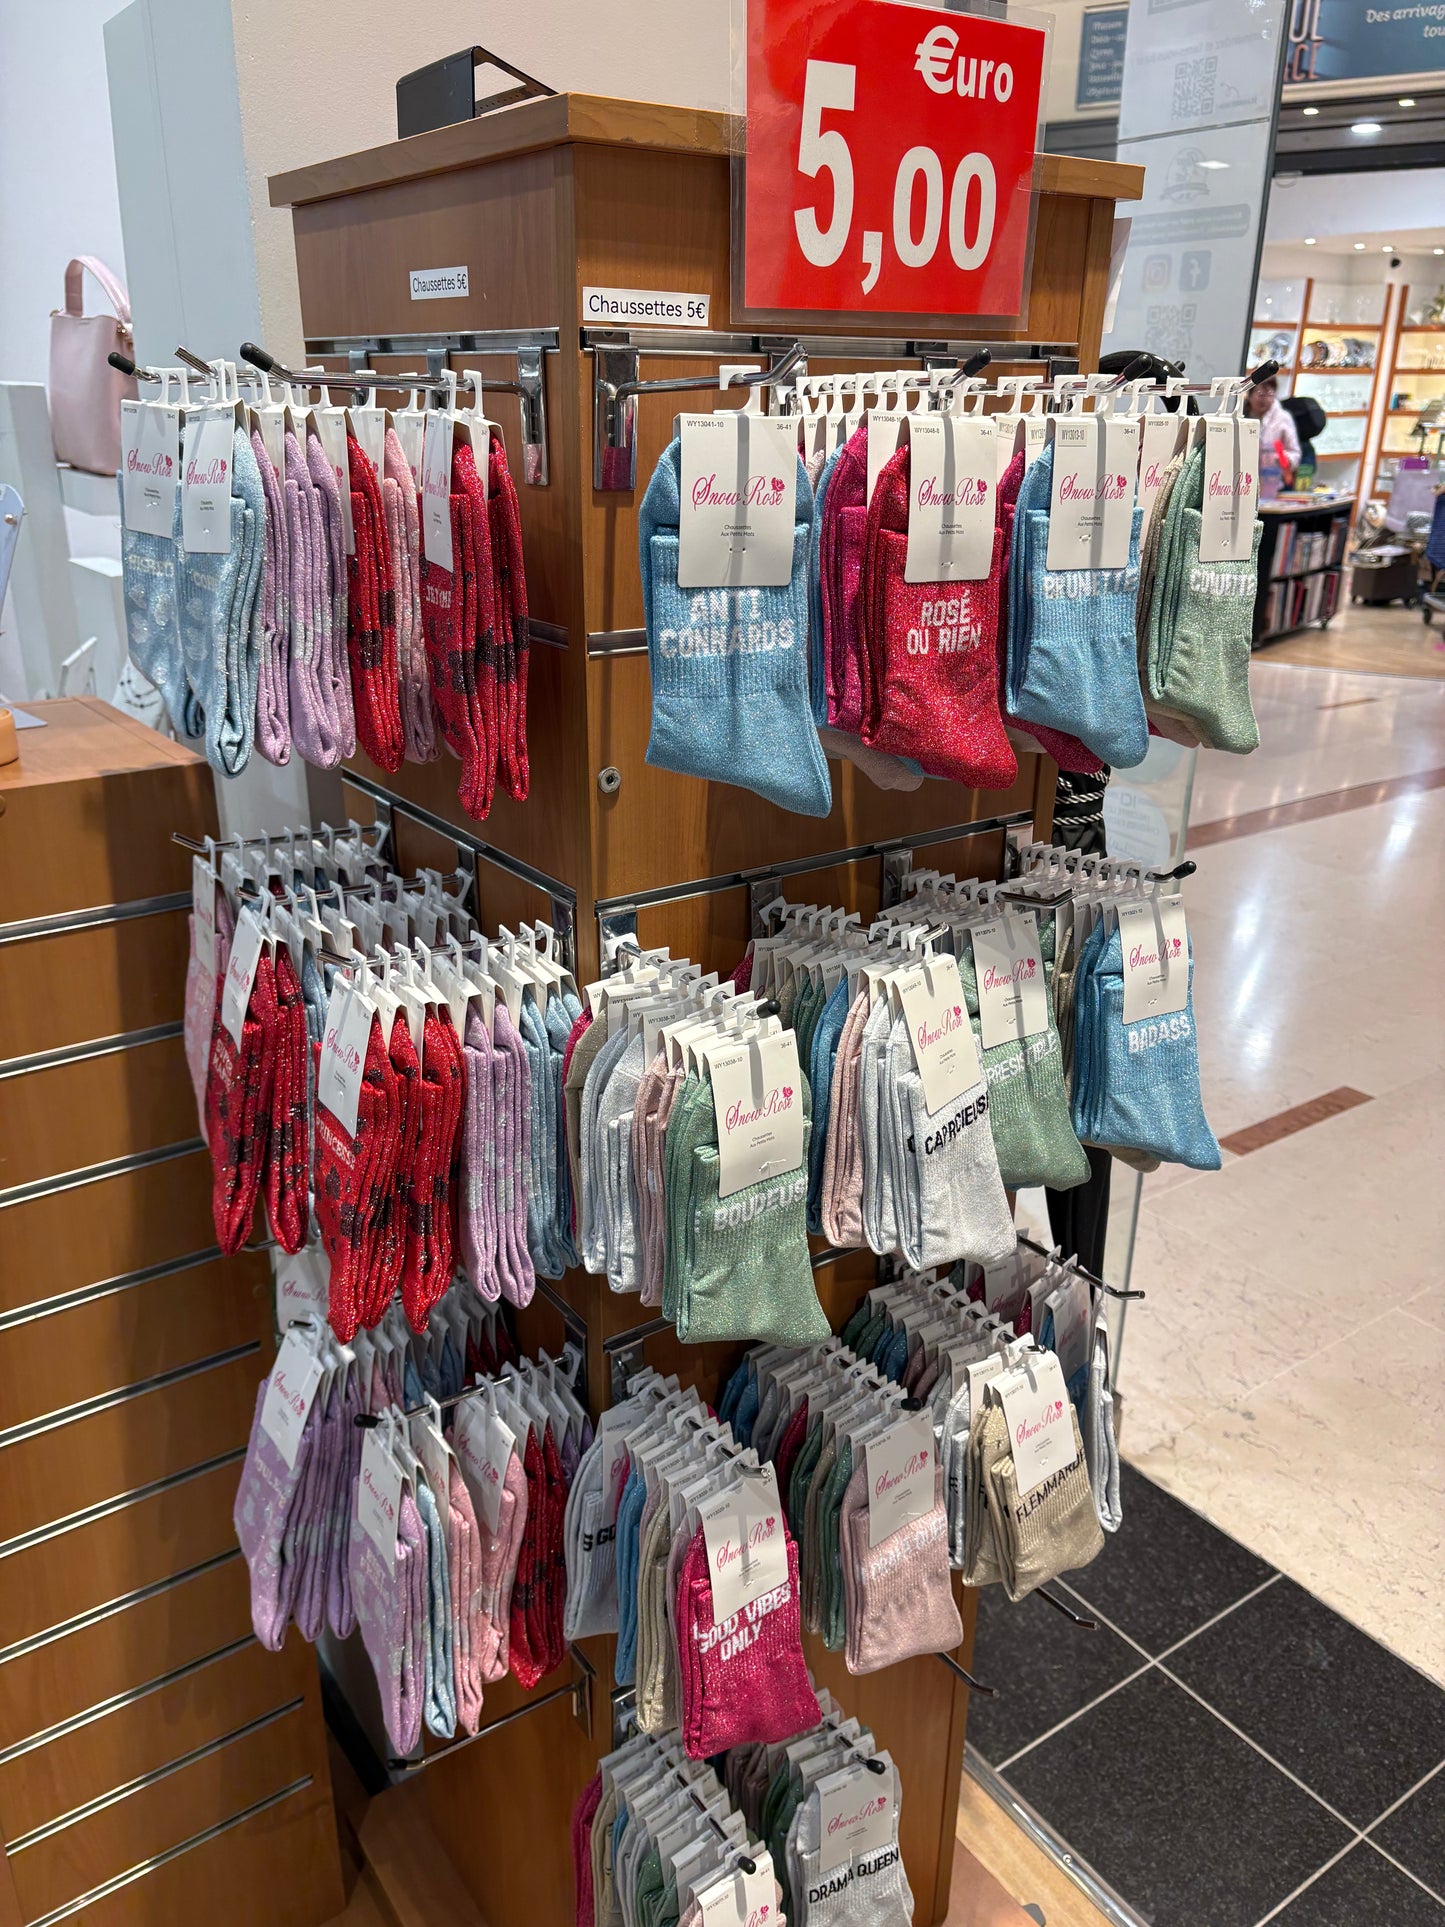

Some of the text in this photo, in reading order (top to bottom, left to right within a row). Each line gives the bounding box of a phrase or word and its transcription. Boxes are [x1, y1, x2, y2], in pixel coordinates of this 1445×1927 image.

[913, 25, 1014, 103] €uro
[794, 58, 997, 296] 5,00
[412, 273, 468, 293] Chaussettes 5€
[589, 294, 706, 319] Chaussettes 5€
[686, 420, 792, 431] WY13041-10 36-41
[127, 448, 152, 475] Snow
[186, 459, 207, 490] Snow
[691, 474, 786, 511] Snow Rose
[918, 477, 986, 511] Snow Rose
[1059, 472, 1125, 505] Snow Rose
[1209, 470, 1251, 500] Snow Rose
[1043, 569, 1138, 601] BRUNETTE
[690, 588, 761, 623] ANTI
[920, 589, 971, 628] ROSÉ
[658, 618, 797, 659] CONNARDS
[906, 624, 982, 656] OU RIEN
[1129, 939, 1181, 972] Snow Rose
[983, 959, 1036, 993] Snow Rose
[917, 1008, 963, 1055] Snow Rose
[1128, 1015, 1191, 1053] BADASS
[326, 1028, 359, 1076] Snow Rose
[725, 1088, 793, 1136] Snow Rose
[1016, 1412, 1041, 1448] Snow
[1040, 1404, 1063, 1431] Rose
[459, 1433, 479, 1466] Snow
[875, 1471, 905, 1499] Snow
[904, 1455, 929, 1481] Rose
[716, 1540, 748, 1573] Snow
[748, 1521, 776, 1549] Rose
[744, 1581, 792, 1623] VIBES
[720, 1620, 763, 1661] ONLY
[827, 1812, 860, 1836] Snow
[859, 1800, 886, 1822] Rose
[808, 1847, 900, 1904] DRAMA QUEEN
